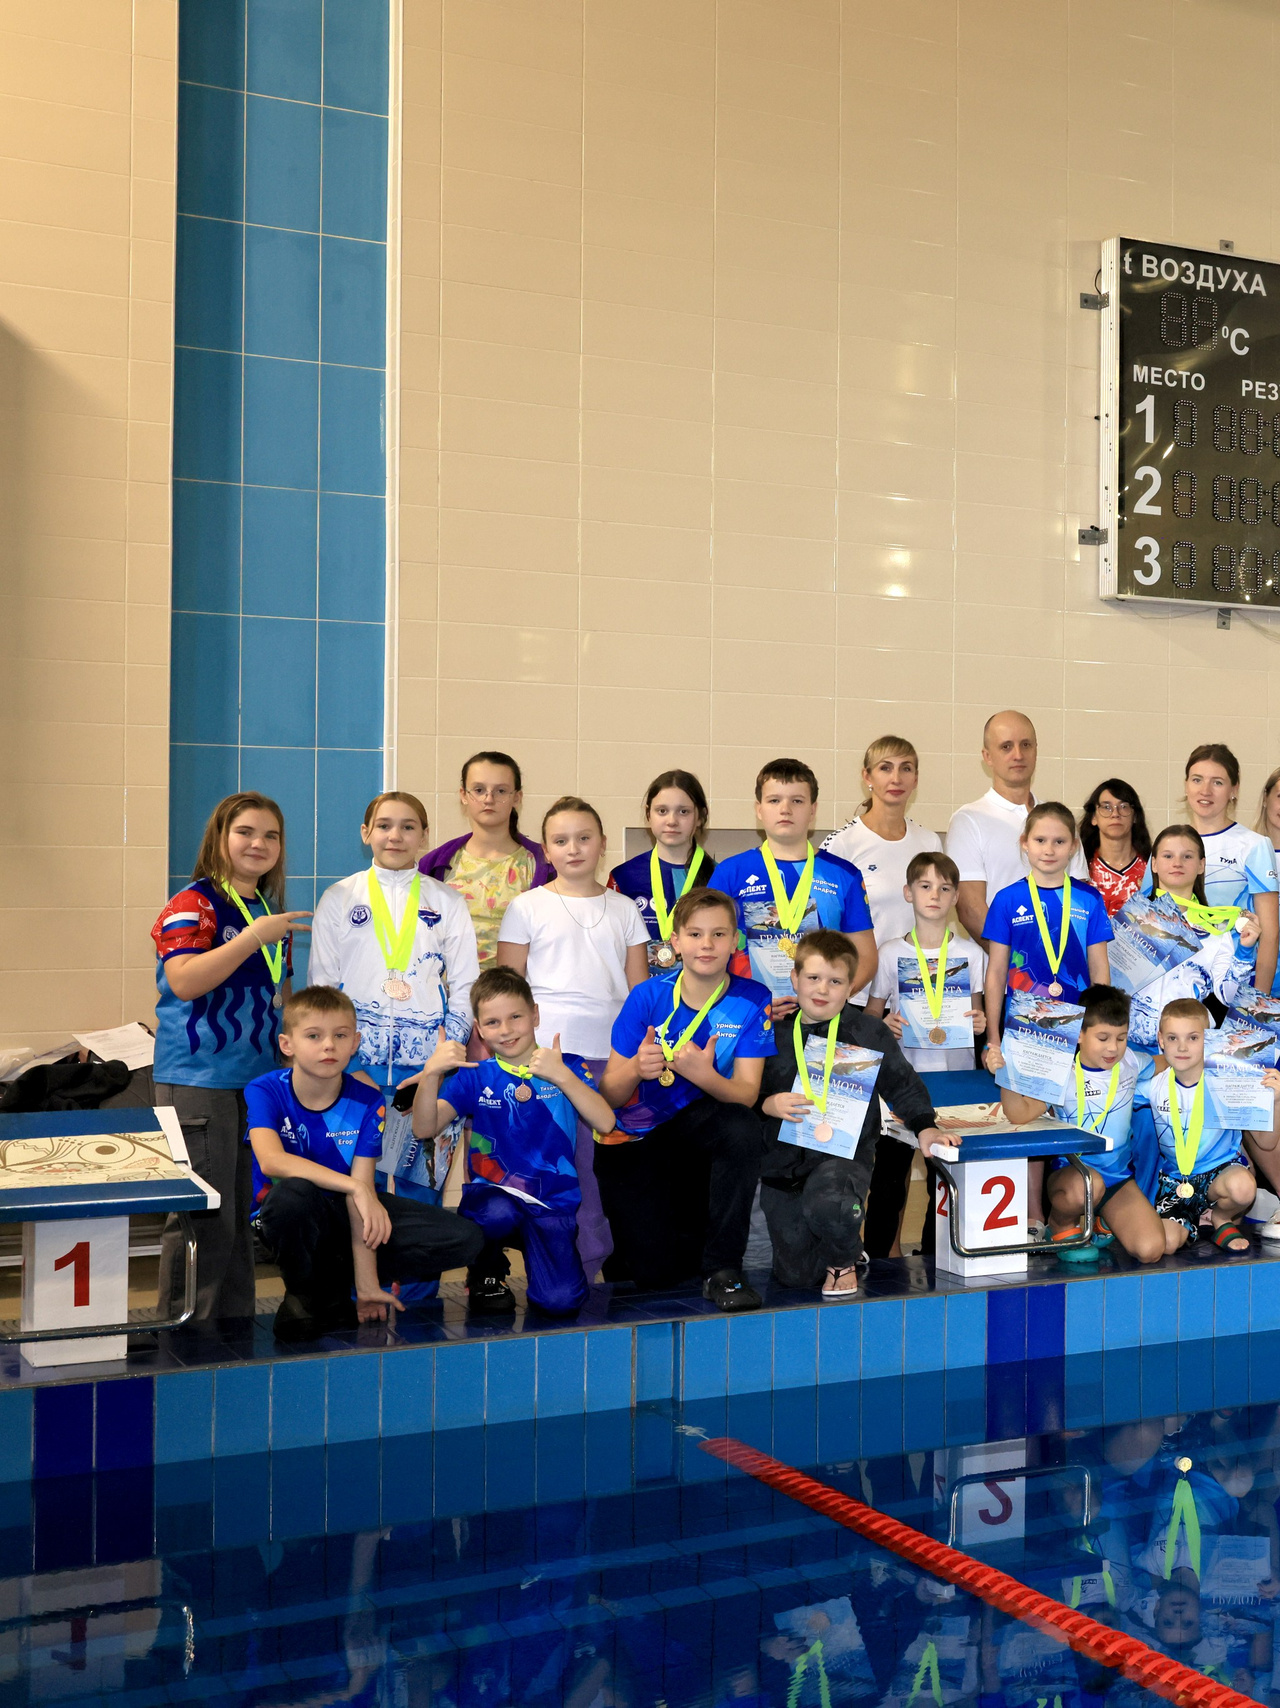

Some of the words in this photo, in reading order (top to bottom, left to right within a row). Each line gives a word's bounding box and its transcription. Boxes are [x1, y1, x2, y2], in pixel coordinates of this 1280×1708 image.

[1142, 254, 1267, 296] ВОЗДУХА
[1133, 365, 1206, 391] МЕСТО
[1135, 394, 1155, 444] 1
[1133, 466, 1162, 515] 2
[1133, 536, 1161, 585] 3
[1121, 922, 1158, 958] ГРАМОТА
[1018, 1026, 1069, 1048] ГРАМОТА
[936, 1180, 949, 1218] 2
[980, 1175, 1019, 1232] 2
[54, 1241, 90, 1307] 1
